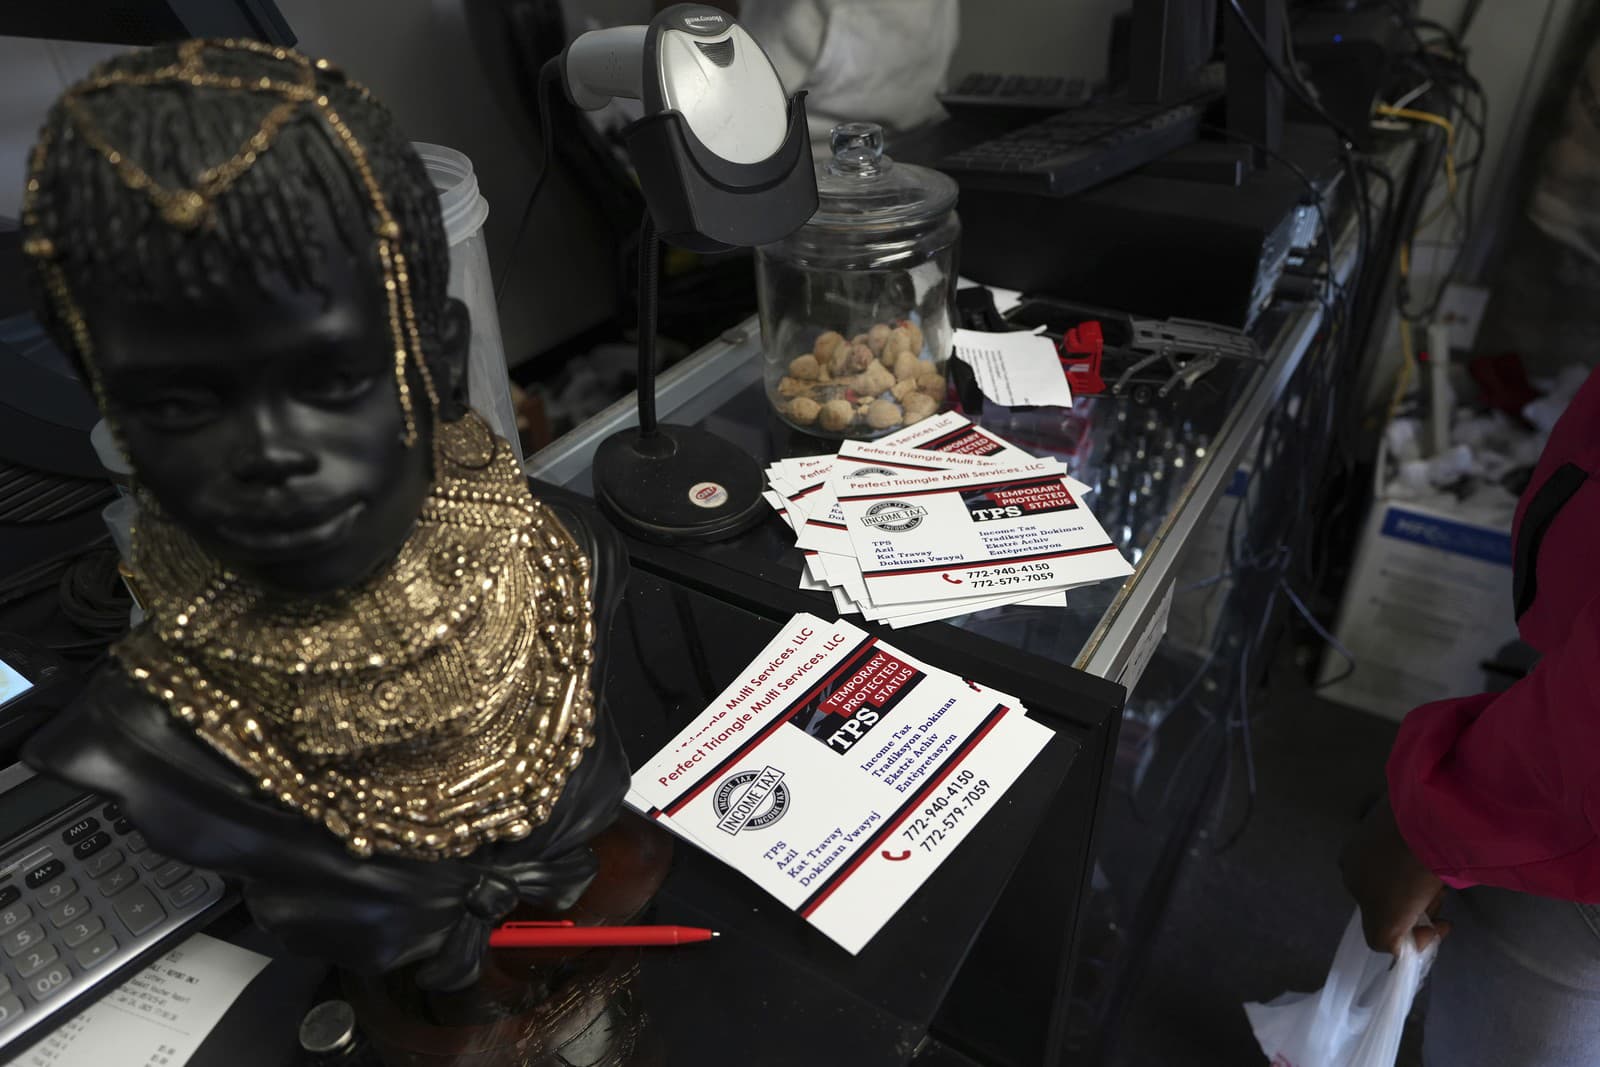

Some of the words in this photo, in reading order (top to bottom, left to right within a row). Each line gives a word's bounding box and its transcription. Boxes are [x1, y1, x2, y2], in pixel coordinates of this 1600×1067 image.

[684, 15, 723, 24] Honeywell
[934, 418, 952, 430] LLC
[857, 446, 896, 458] Perfect
[899, 451, 944, 462] Triangle
[945, 457, 974, 466] Multi
[974, 443, 997, 456] ATUS
[850, 480, 892, 488] Perfect
[894, 474, 938, 486] Triangle
[942, 472, 970, 480] Multi
[972, 466, 1023, 479] Services,
[1026, 462, 1046, 470] LLC
[995, 484, 1062, 498] TEMPORARY
[1002, 491, 1066, 505] PROTECTED
[1029, 498, 1072, 510] STATUS
[863, 512, 902, 524] INCOME
[903, 508, 923, 518] TAX
[971, 506, 1022, 521] TPS
[979, 528, 1016, 536] Income
[982, 532, 1036, 543] Tradiksyon
[1039, 526, 1084, 536] Dokiman
[989, 543, 1062, 556] Entèpretasyon
[1022, 538, 1049, 546] Achiv
[880, 558, 926, 566] Dokiman
[928, 554, 964, 563] Vwayaj
[897, 550, 932, 559] Travay
[966, 562, 1050, 579] 772-940-4150
[971, 572, 1054, 588] 772-579-7059
[726, 685, 755, 710] Multi
[750, 644, 798, 687] Services,
[792, 627, 814, 646] LLC
[826, 654, 887, 708] TEMPORARY
[842, 661, 899, 713] PROTECTED
[874, 668, 913, 703] STATUS
[658, 750, 707, 787] Perfect
[702, 712, 752, 752] Triangle
[750, 688, 781, 714] Multi
[778, 650, 828, 692] Services,
[823, 633, 846, 652] LLC
[828, 706, 880, 750] TPS
[872, 731, 920, 779] Tradiksyon
[918, 696, 956, 732] Dokiman
[860, 740, 894, 772] Income
[892, 724, 912, 742] Tax
[883, 757, 915, 786] Ekstrè
[913, 732, 939, 759] Achiv
[894, 733, 958, 794] Entèpretasyon
[719, 780, 734, 811] INCOME
[735, 775, 751, 784] TAX
[722, 789, 763, 832] INCOME
[756, 770, 780, 793] TAX
[754, 805, 782, 826] INCOME
[775, 790, 785, 806] TAX
[902, 769, 975, 842] 772-940-4150
[920, 779, 991, 852] 772-579-7059
[70, 821, 88, 837] MU
[80, 836, 98, 850] GT
[763, 840, 787, 861] TPS
[799, 844, 847, 888] Dokiman
[844, 810, 882, 843] Vwayaj
[776, 849, 799, 870] Azil
[787, 860, 809, 879] Kat
[806, 826, 844, 860] Travay
[35, 866, 52, 880] M+
[50, 884, 62, 896] 9
[4, 912, 16, 925] 8
[64, 904, 76, 916] 6
[16, 930, 30, 946] 5
[75, 924, 88, 937] 3
[28, 954, 44, 968] 2
[36, 970, 63, 992] 00
